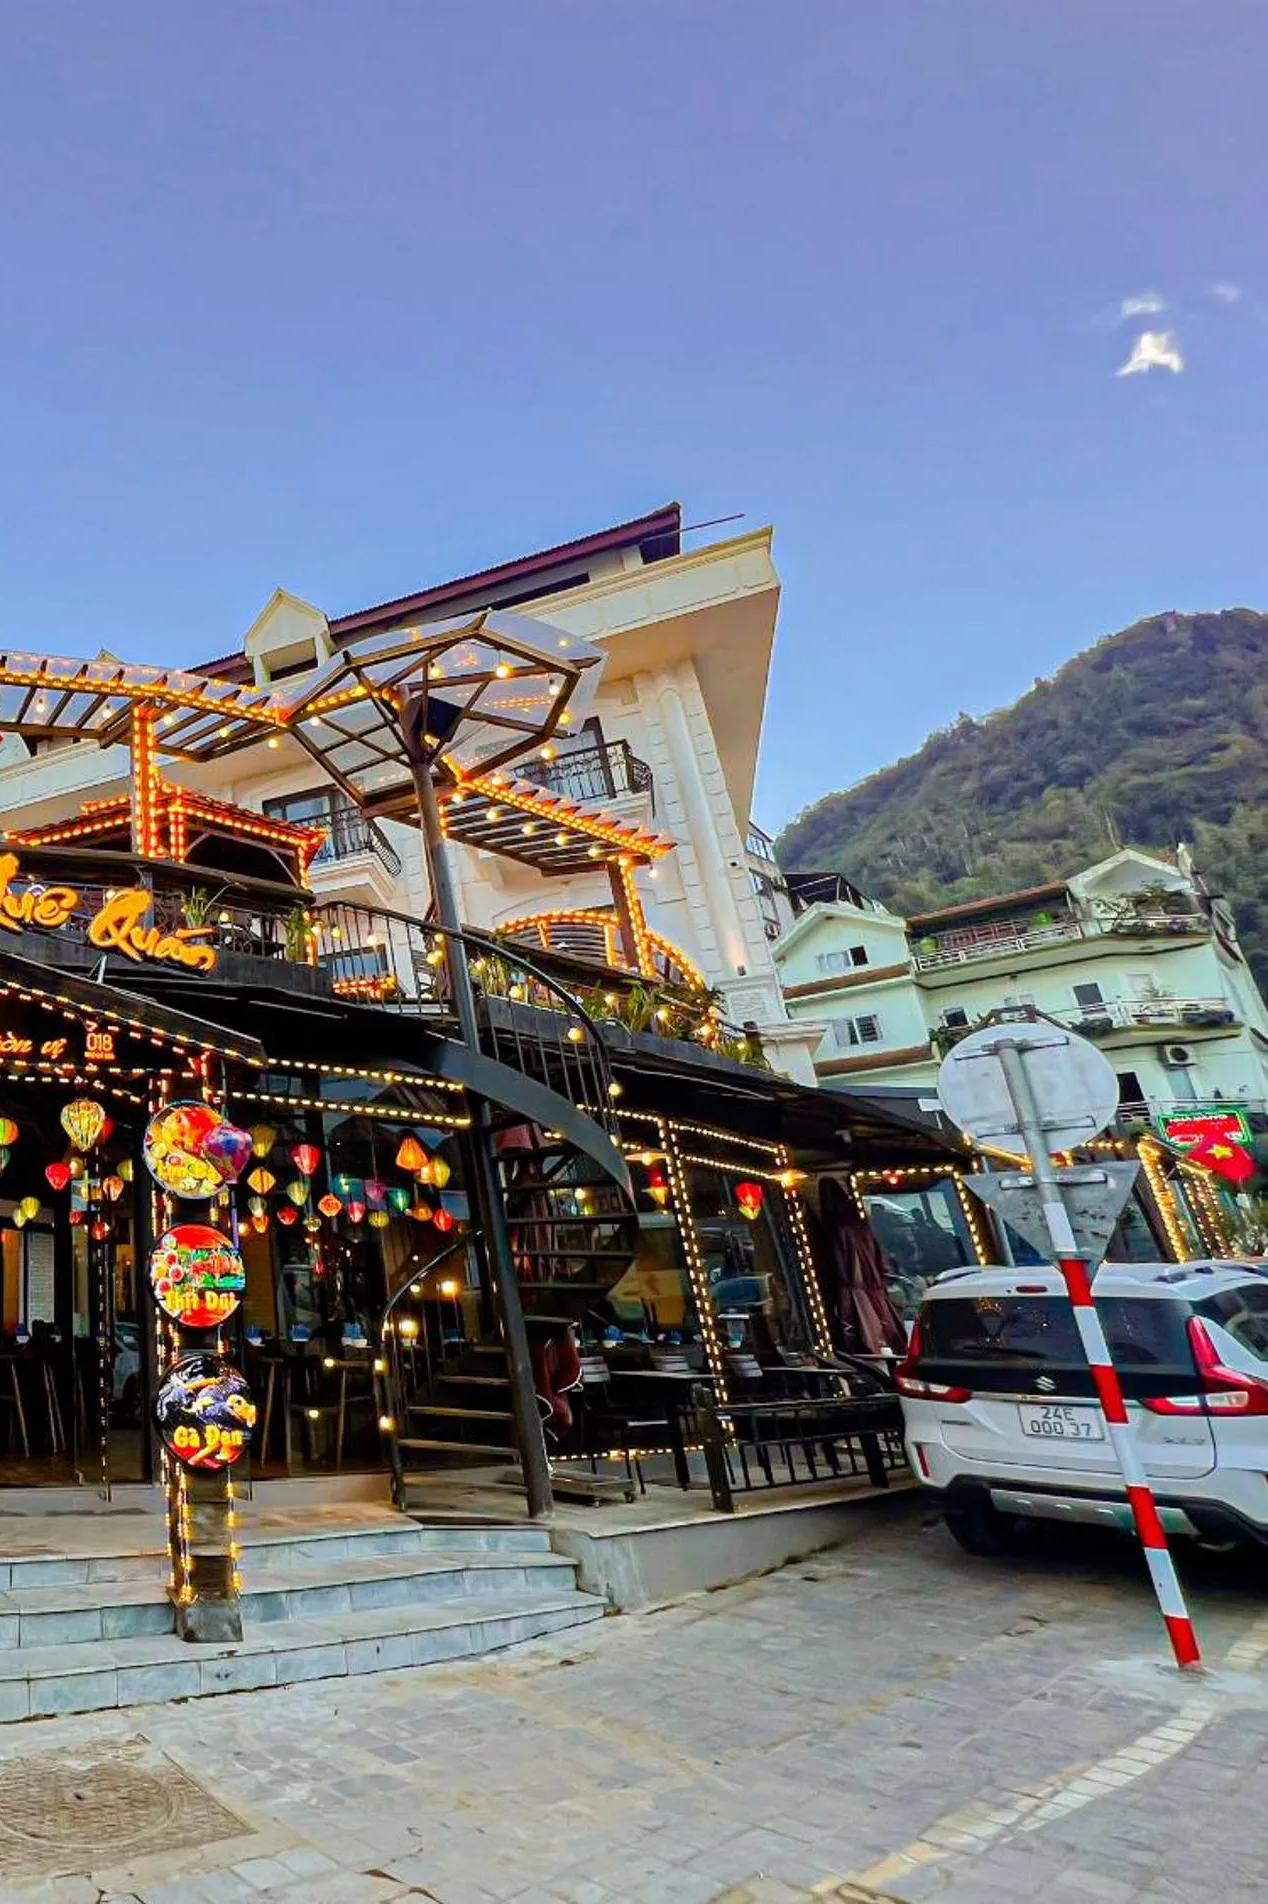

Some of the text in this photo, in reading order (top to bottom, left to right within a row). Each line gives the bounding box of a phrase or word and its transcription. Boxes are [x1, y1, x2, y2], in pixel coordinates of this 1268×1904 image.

[88, 886, 218, 975] Quán
[40, 1038, 67, 1060] vị
[86, 1032, 113, 1051] 018
